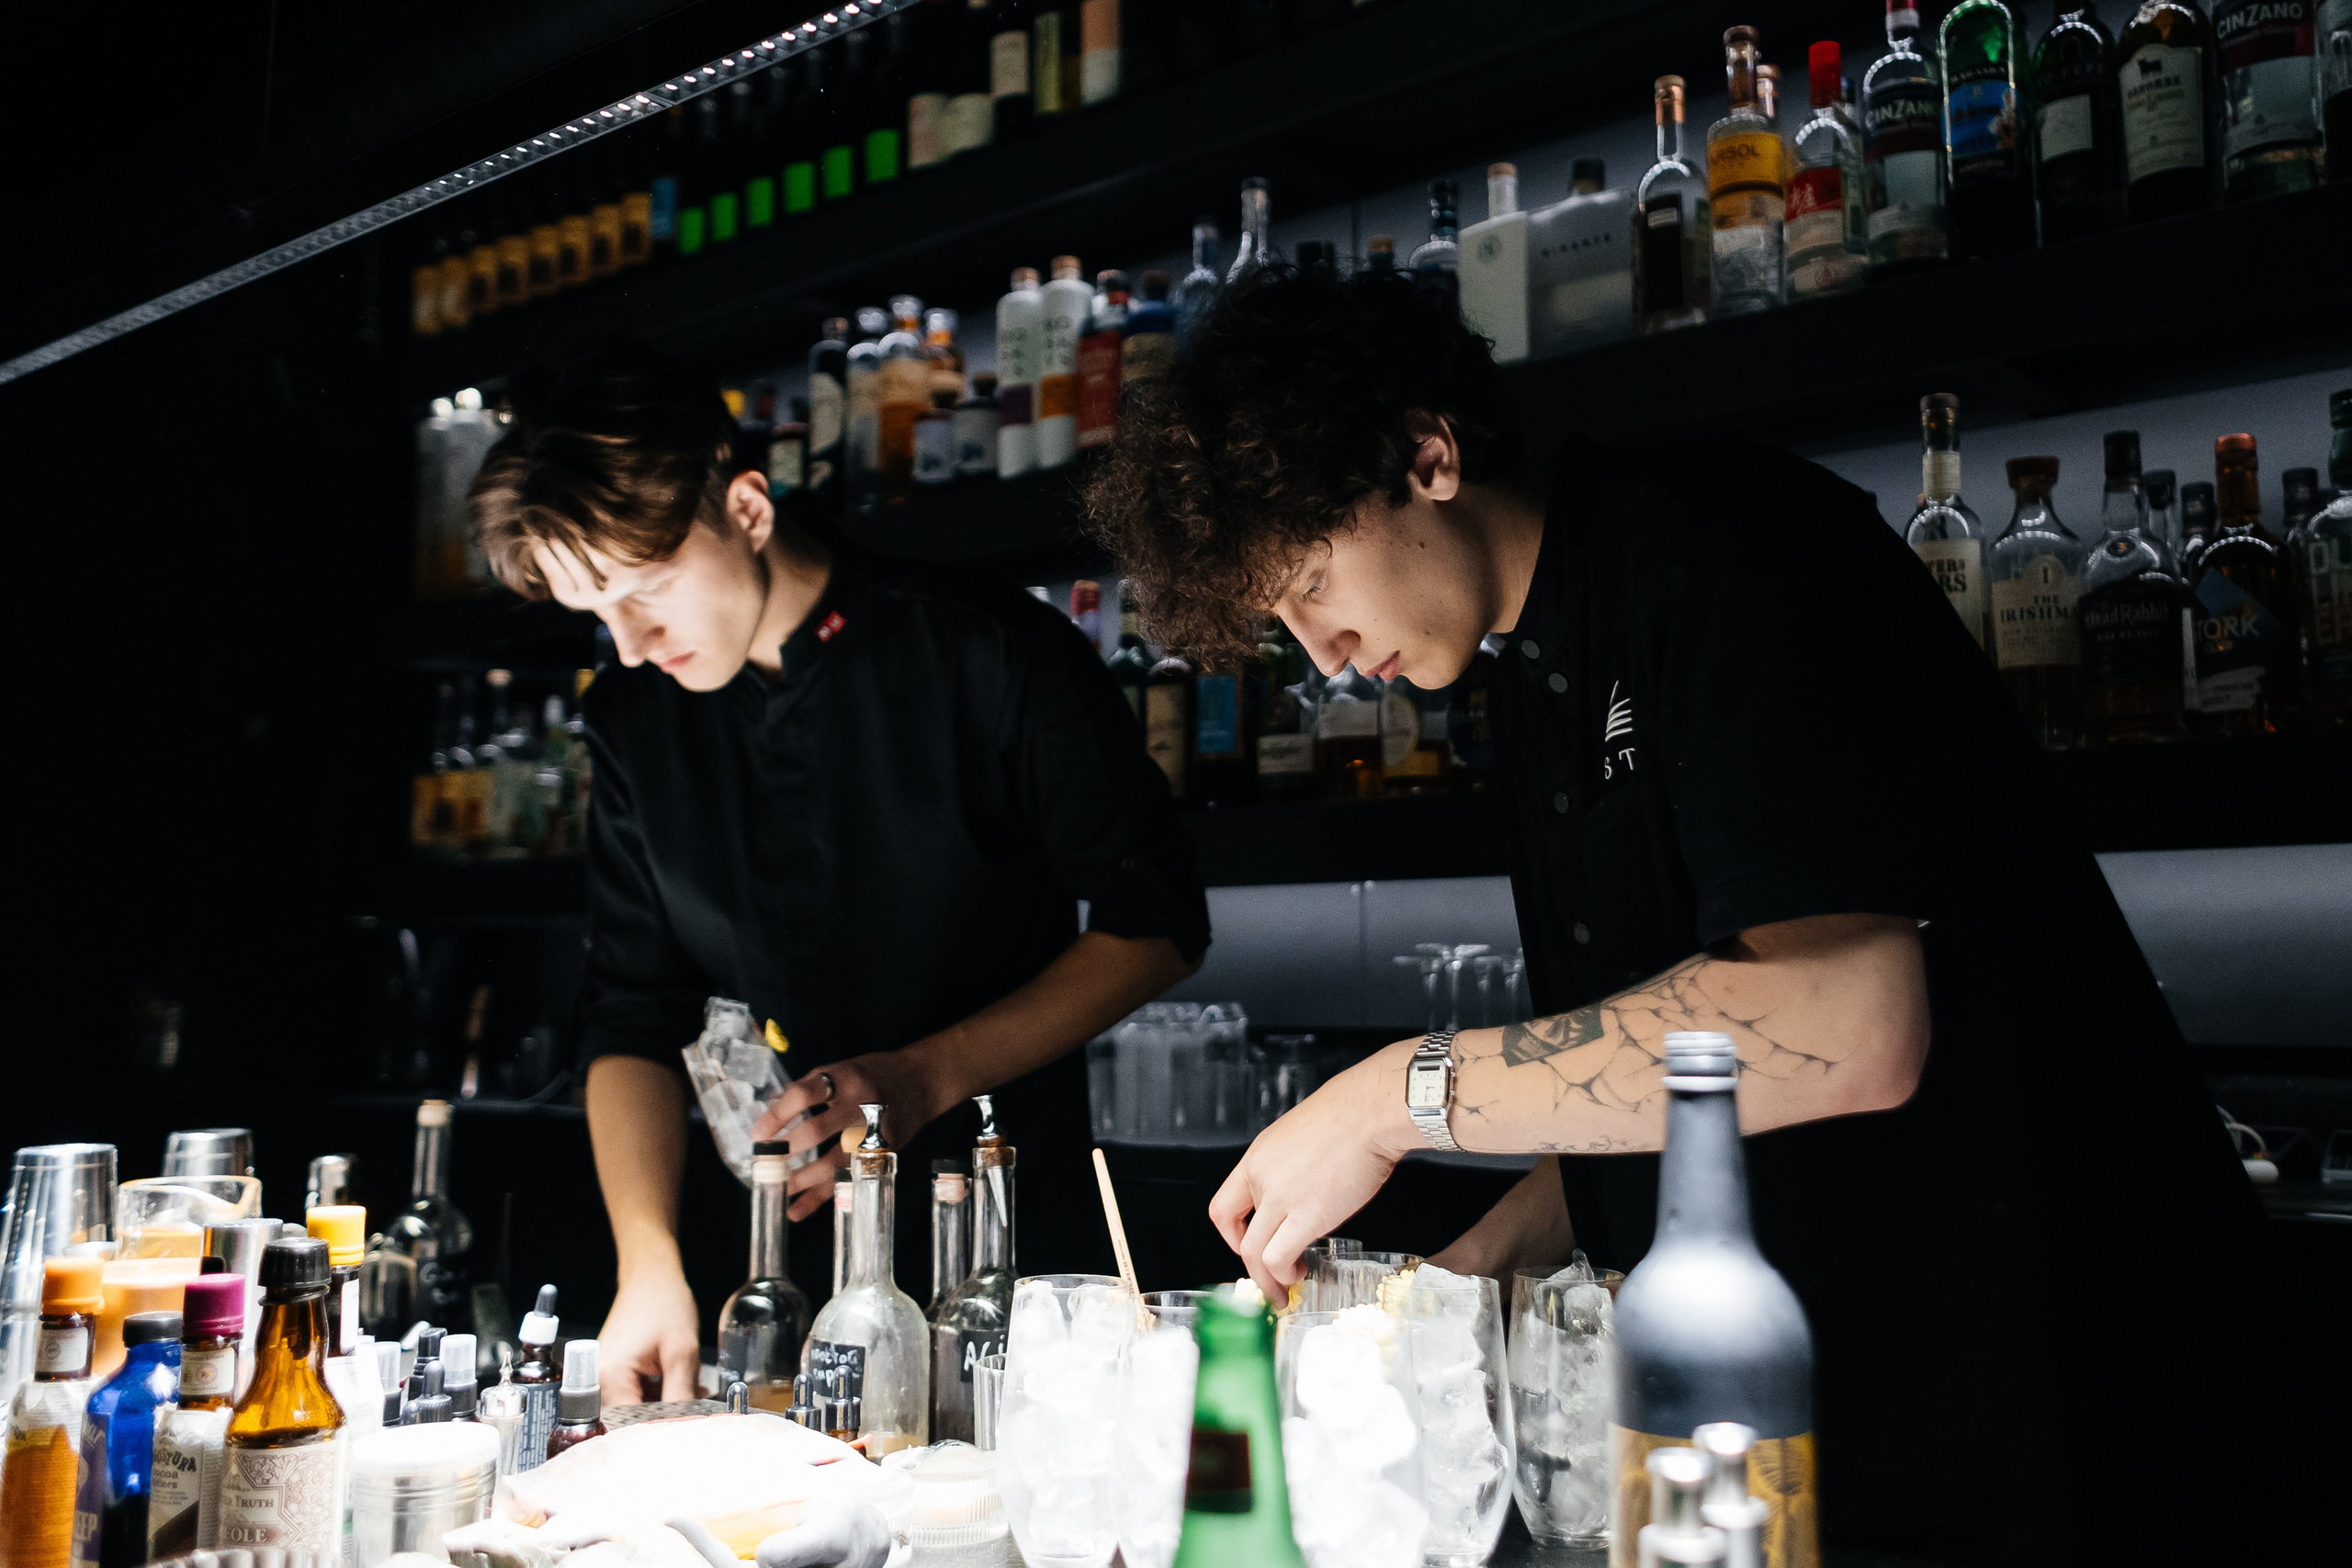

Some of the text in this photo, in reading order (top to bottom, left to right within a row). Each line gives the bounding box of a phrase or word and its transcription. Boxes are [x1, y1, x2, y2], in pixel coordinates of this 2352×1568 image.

[2216, 3, 2303, 39] CINZANO
[1865, 98, 1939, 133] CINZANO
[2033, 594, 2059, 604] THE
[2000, 606, 2079, 623] IRISHMA
[2195, 613, 2261, 642] TORK
